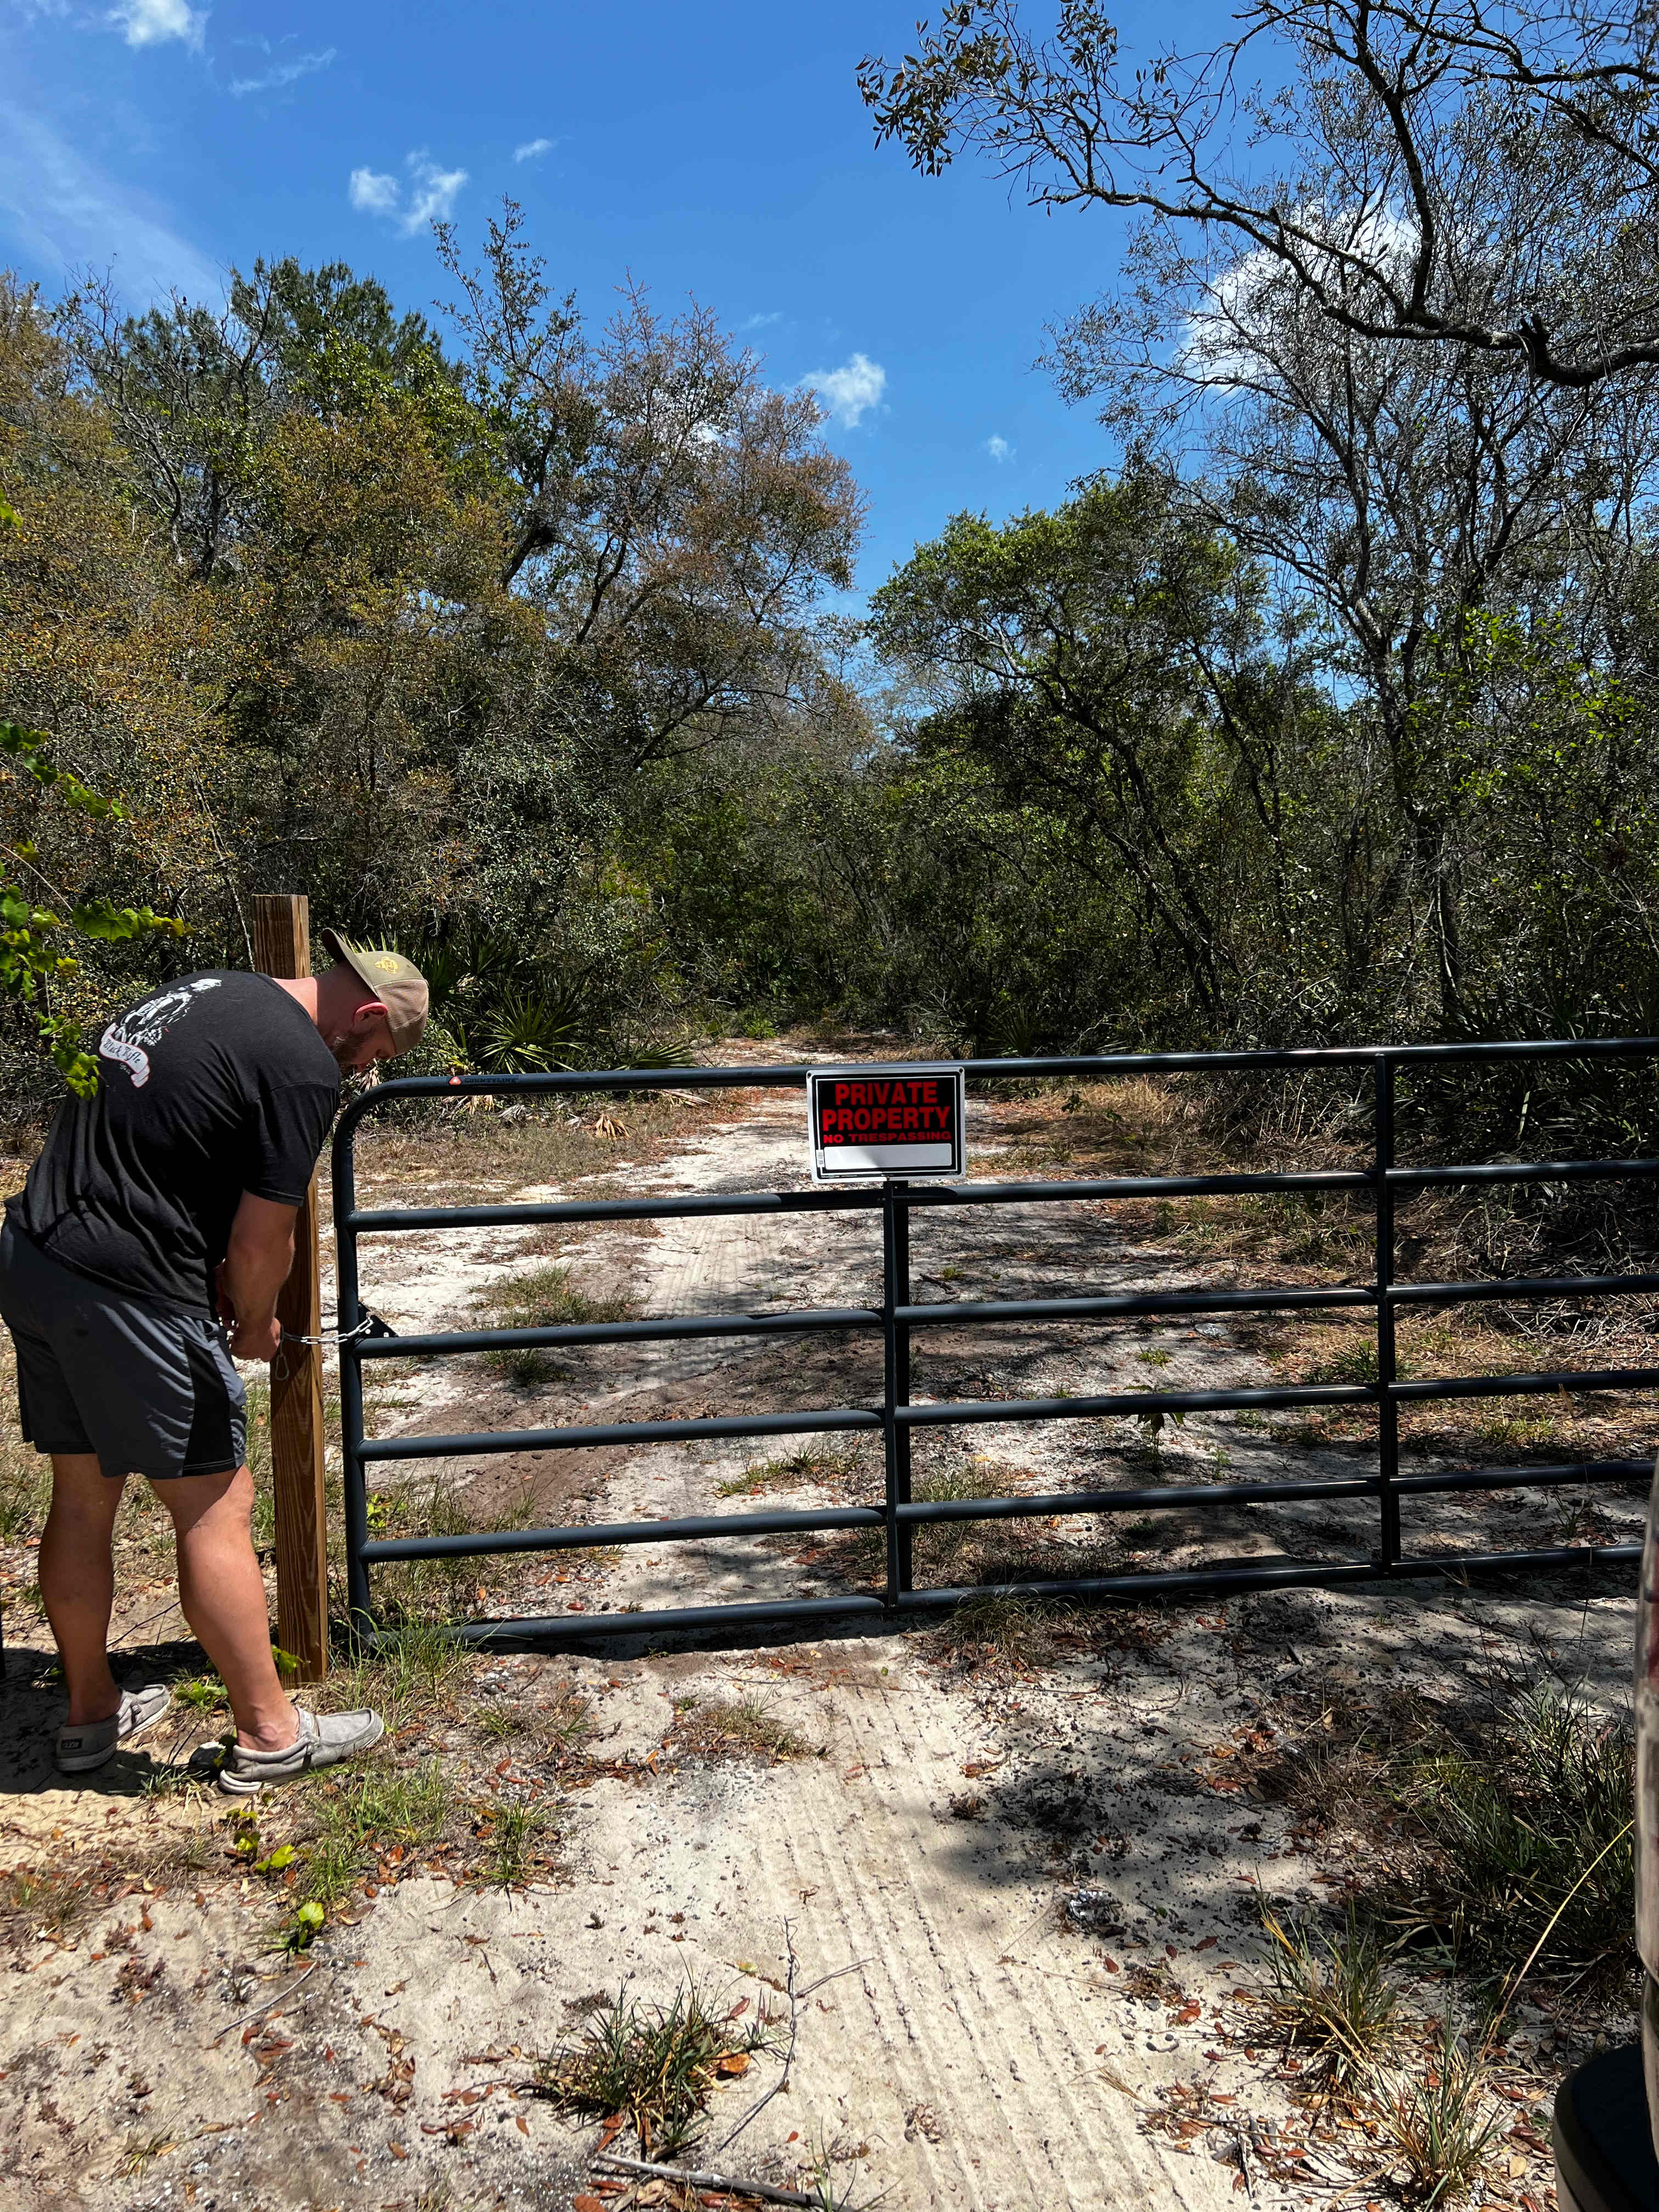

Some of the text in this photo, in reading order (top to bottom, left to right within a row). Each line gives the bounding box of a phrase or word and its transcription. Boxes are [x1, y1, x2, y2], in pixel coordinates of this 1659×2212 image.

[103, 1039, 122, 1057] Black
[835, 1081, 938, 1105] PRIVATE
[822, 1106, 951, 1131] PROPERTY
[823, 1131, 952, 1144] NO TRESPASSING
